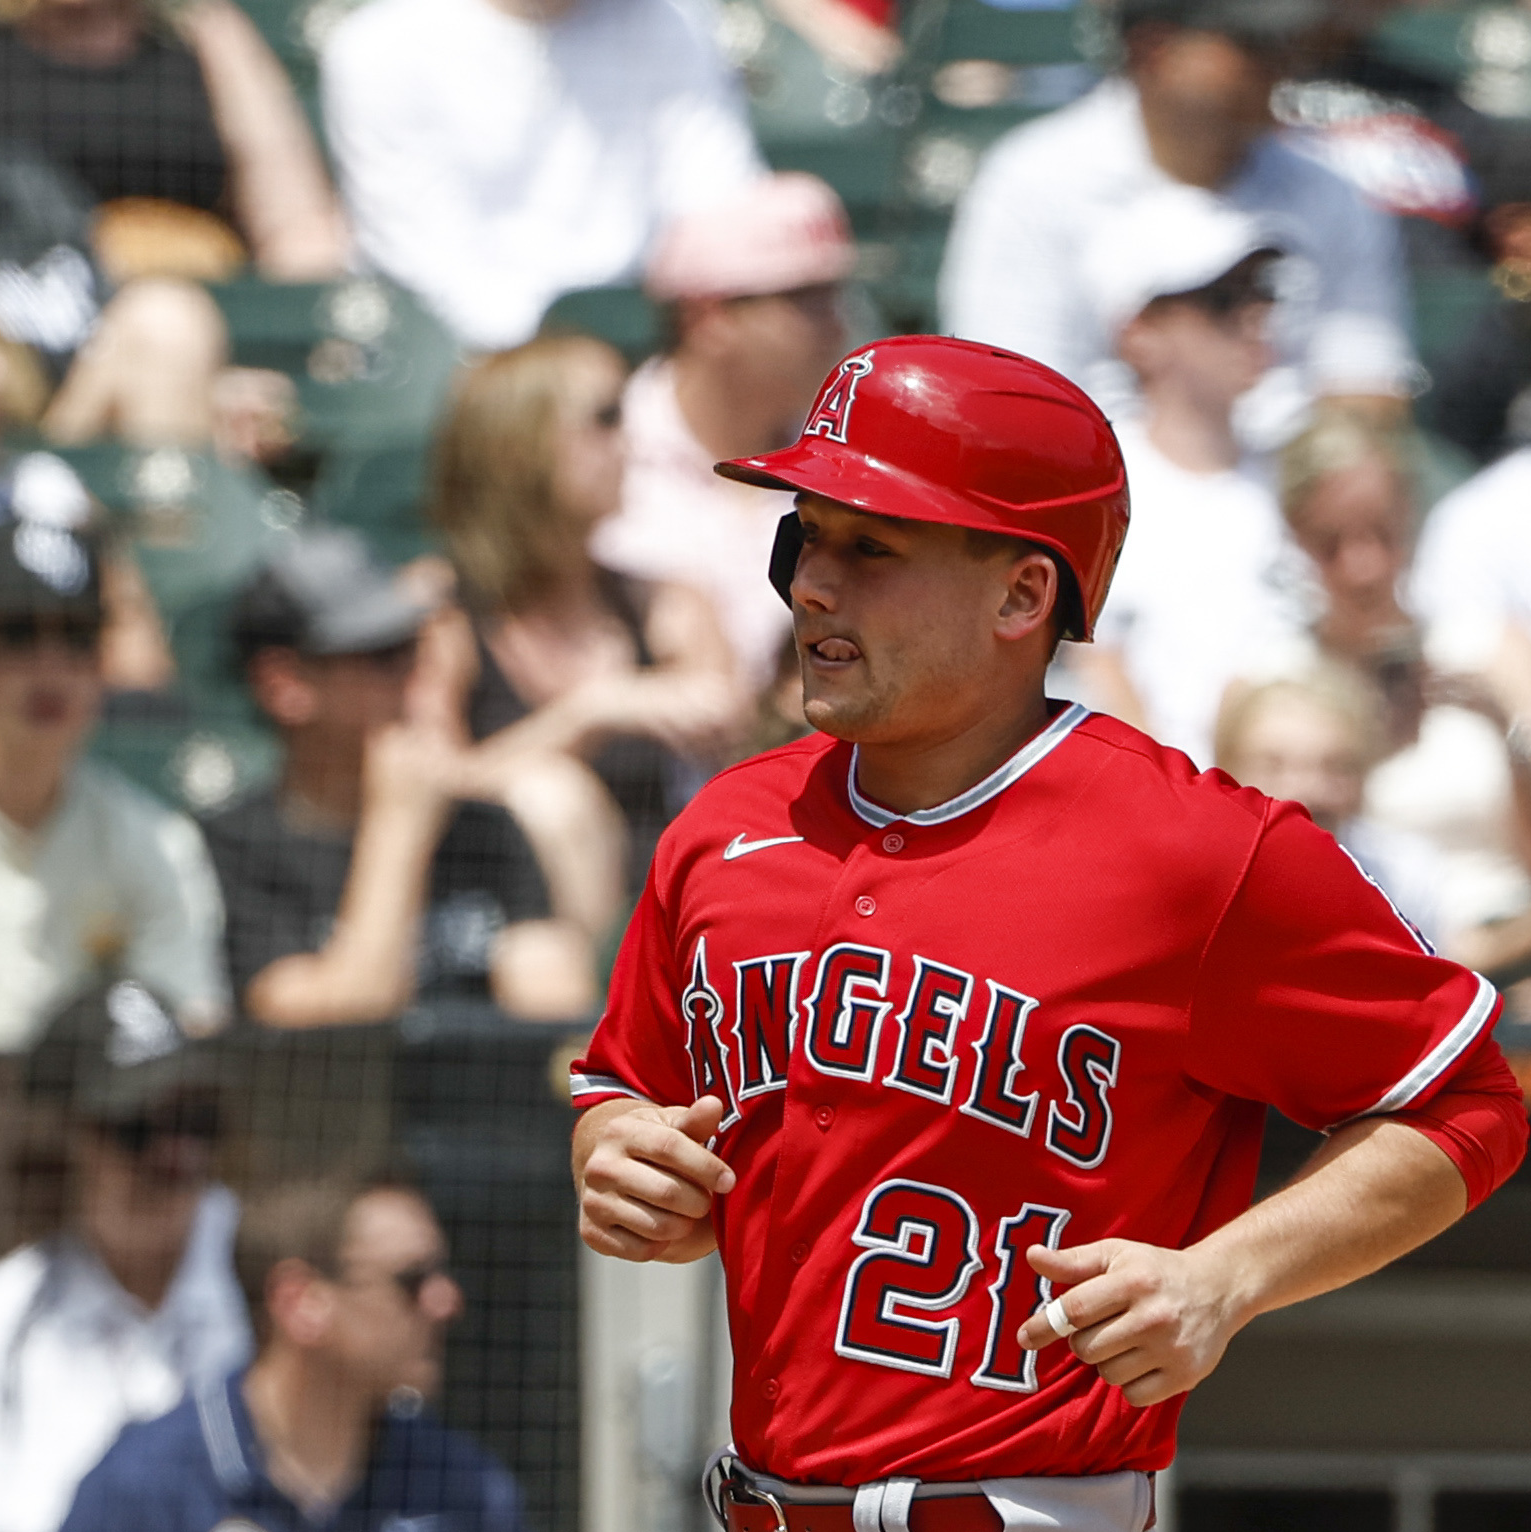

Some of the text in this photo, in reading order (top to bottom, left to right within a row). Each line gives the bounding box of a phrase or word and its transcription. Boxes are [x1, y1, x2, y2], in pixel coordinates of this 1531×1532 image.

[804, 349, 875, 444] A
[682, 936, 1121, 1169] ANGELS
[835, 1179, 1071, 1393] 21
